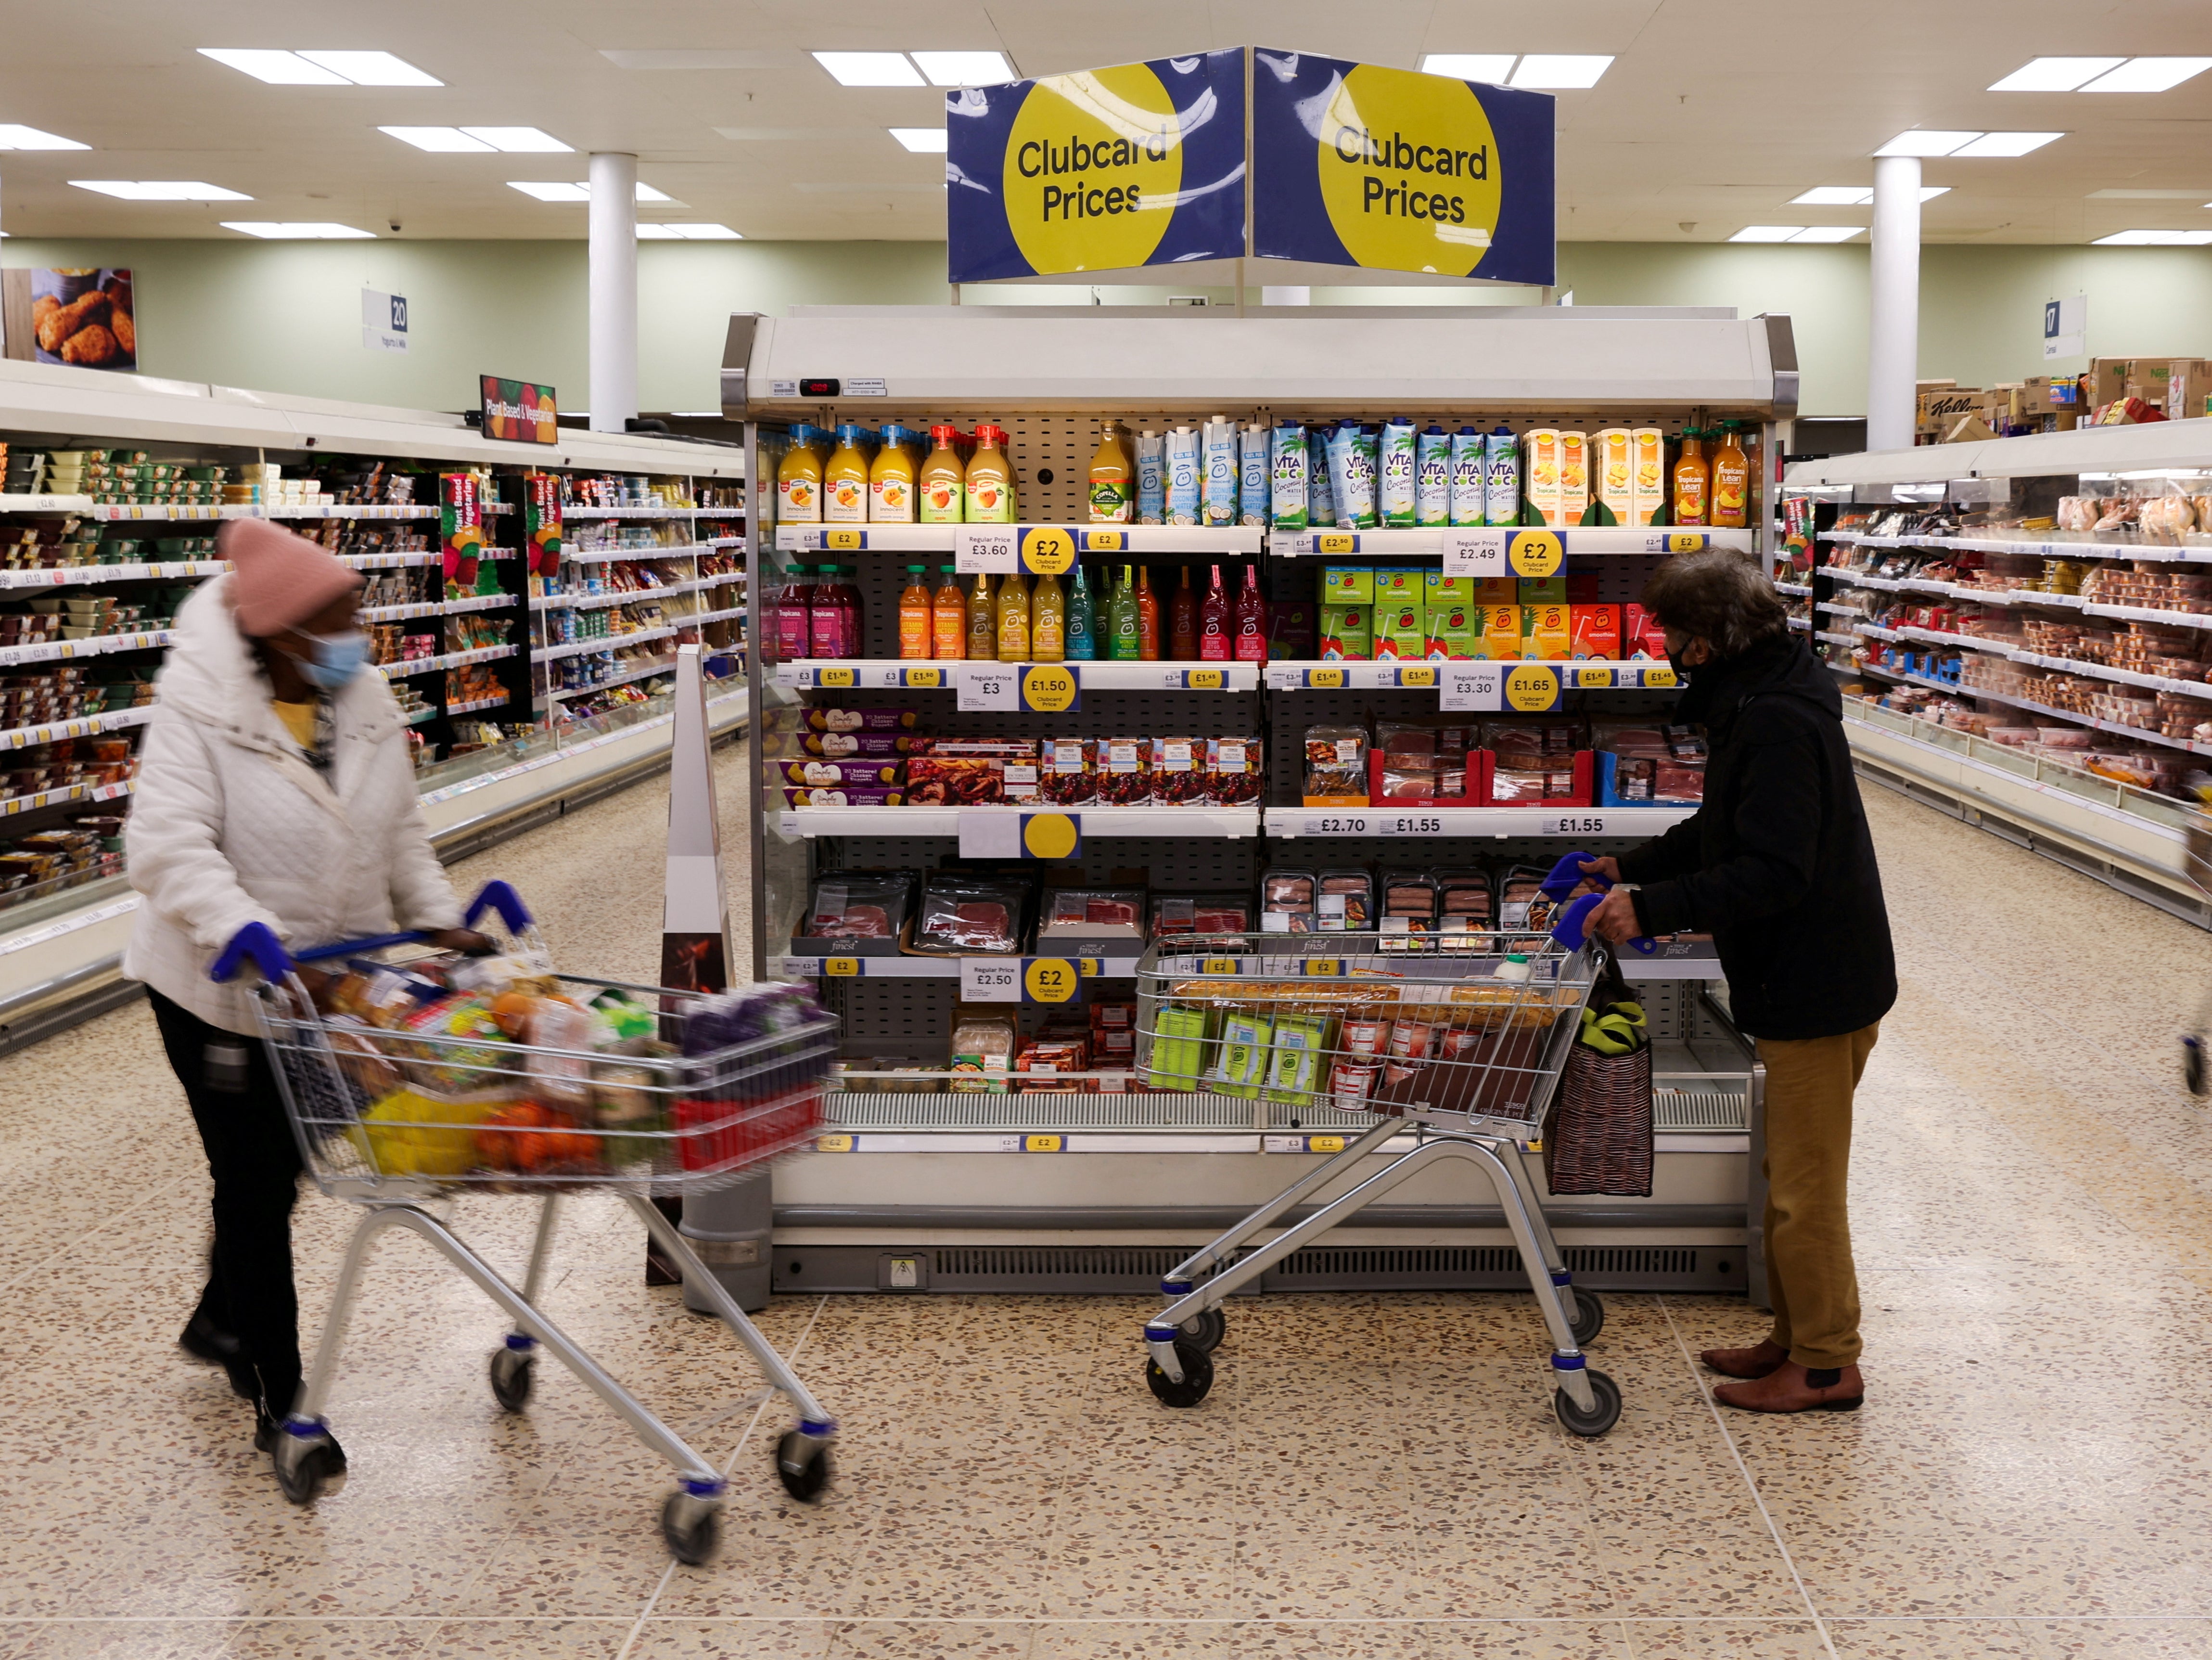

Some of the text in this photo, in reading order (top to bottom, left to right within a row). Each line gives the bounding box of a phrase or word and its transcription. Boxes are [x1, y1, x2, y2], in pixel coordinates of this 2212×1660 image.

[1018, 123, 1168, 179] Clubcard
[1335, 127, 1487, 181] Clubcard
[1043, 181, 1141, 222] Prices
[1363, 176, 1465, 223] Prices
[393, 300, 406, 327] 20
[2047, 308, 2056, 332] 17
[486, 399, 554, 425] Plant Based & Vegetarian
[1275, 455, 1300, 468] VITA
[1387, 452, 1412, 465] VITA
[1274, 468, 1304, 479] COCO
[1420, 462, 1446, 475] VITA
[1454, 462, 1480, 475] VITA
[1489, 463, 1514, 475] VITA
[1719, 466, 1745, 475] Tropicana
[1419, 476, 1448, 485] COCO
[1453, 476, 1483, 485] COCO
[1487, 476, 1518, 486] COCO
[1677, 475, 1704, 484] Tropicana
[1096, 490, 1118, 500] COPELLA
[453, 478, 463, 533] Plant Based
[464, 479, 474, 528] Vegetarian
[536, 480, 546, 529] Plant Based
[545, 480, 556, 525] Vegetarian
[1788, 502, 1796, 521] Based
[1795, 501, 1804, 534] Vegetarian
[972, 545, 1007, 555] £3.60
[1036, 540, 1059, 556] £2
[1460, 549, 1495, 559] £2.49
[1524, 543, 1547, 559] £2
[983, 683, 999, 694] £3
[1031, 681, 1066, 691] £1.50
[1457, 683, 1492, 693] £3.30
[1514, 680, 1549, 690] £1.65
[1322, 819, 1365, 832] £2.70
[1397, 819, 1440, 832] £1.55
[1560, 819, 1603, 832] £1.55
[830, 940, 856, 952] finest
[1076, 945, 1102, 956] finest
[1663, 944, 1690, 956] finest
[978, 975, 1011, 985] £2.50
[1039, 971, 1062, 985] £2
